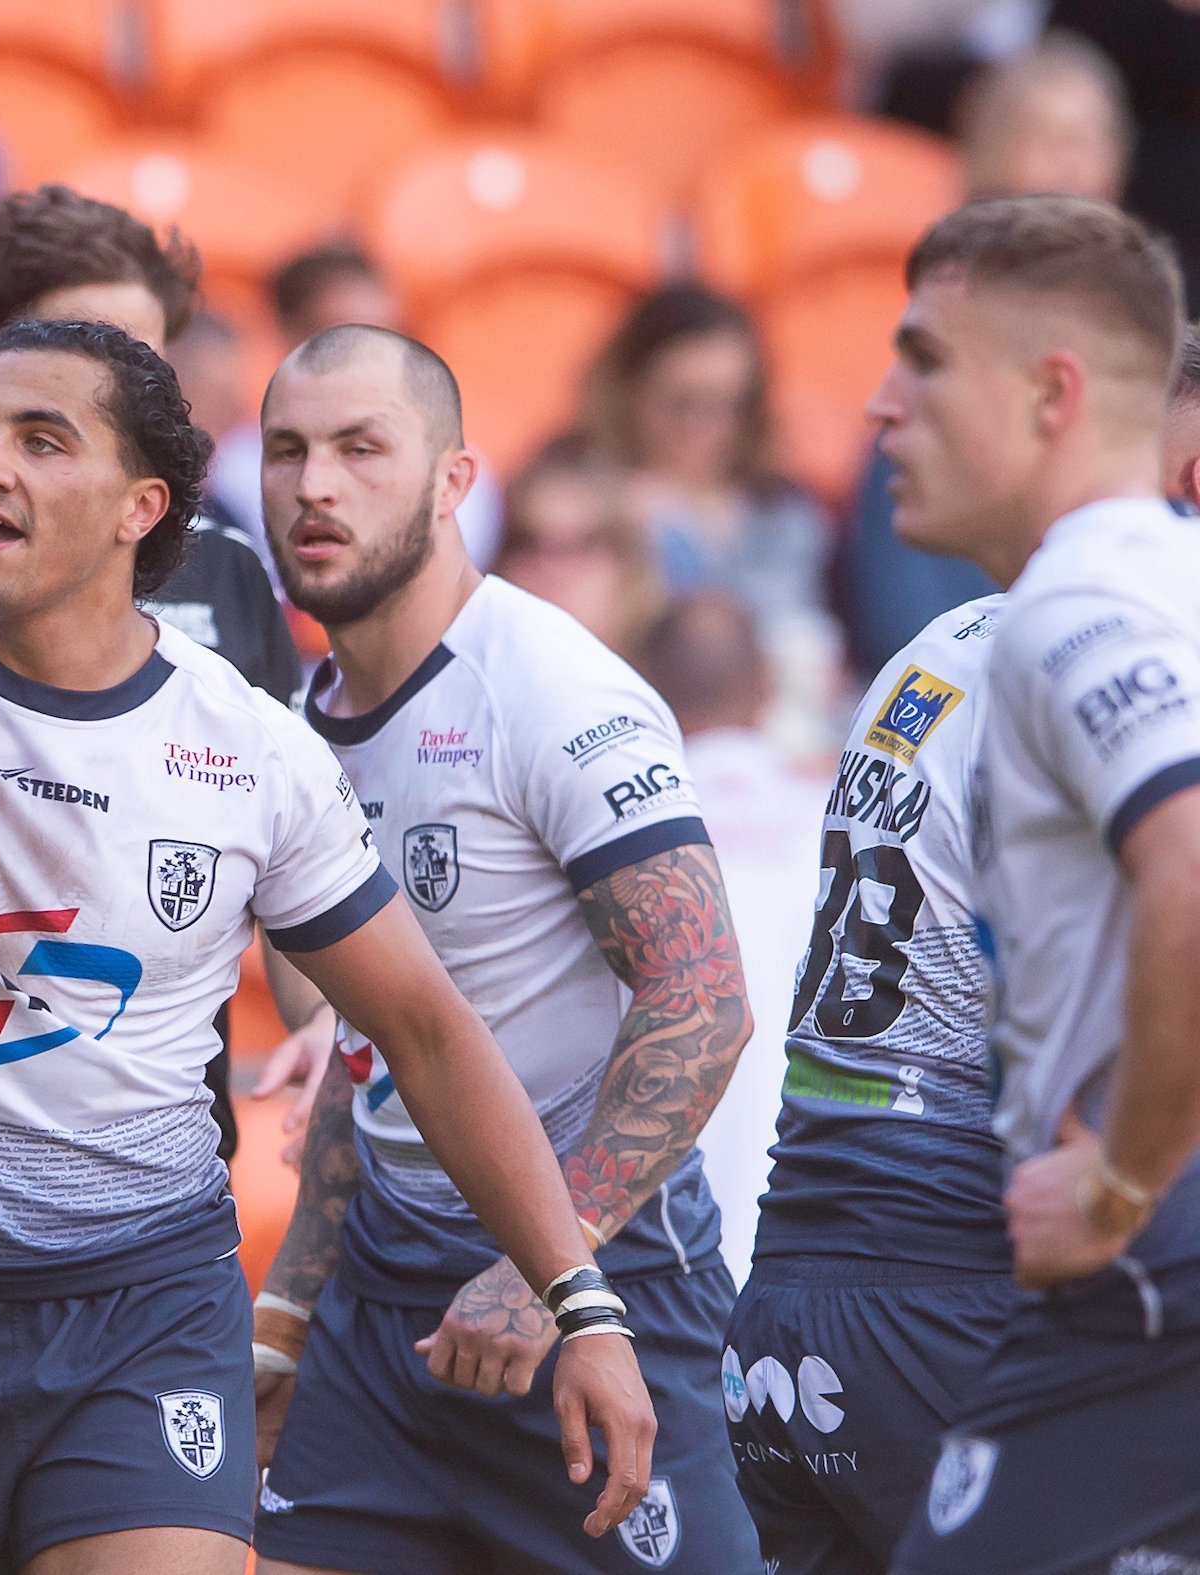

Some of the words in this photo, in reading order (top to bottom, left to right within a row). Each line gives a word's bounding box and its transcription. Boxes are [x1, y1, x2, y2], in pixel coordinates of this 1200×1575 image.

[889, 697, 934, 741] CPM
[419, 727, 468, 751] Taylor
[164, 742, 239, 769] Taylor
[417, 748, 485, 768] Wimpey
[164, 758, 260, 792] Wimpey
[16, 776, 111, 813] STEEDEN
[186, 884, 196, 896] R
